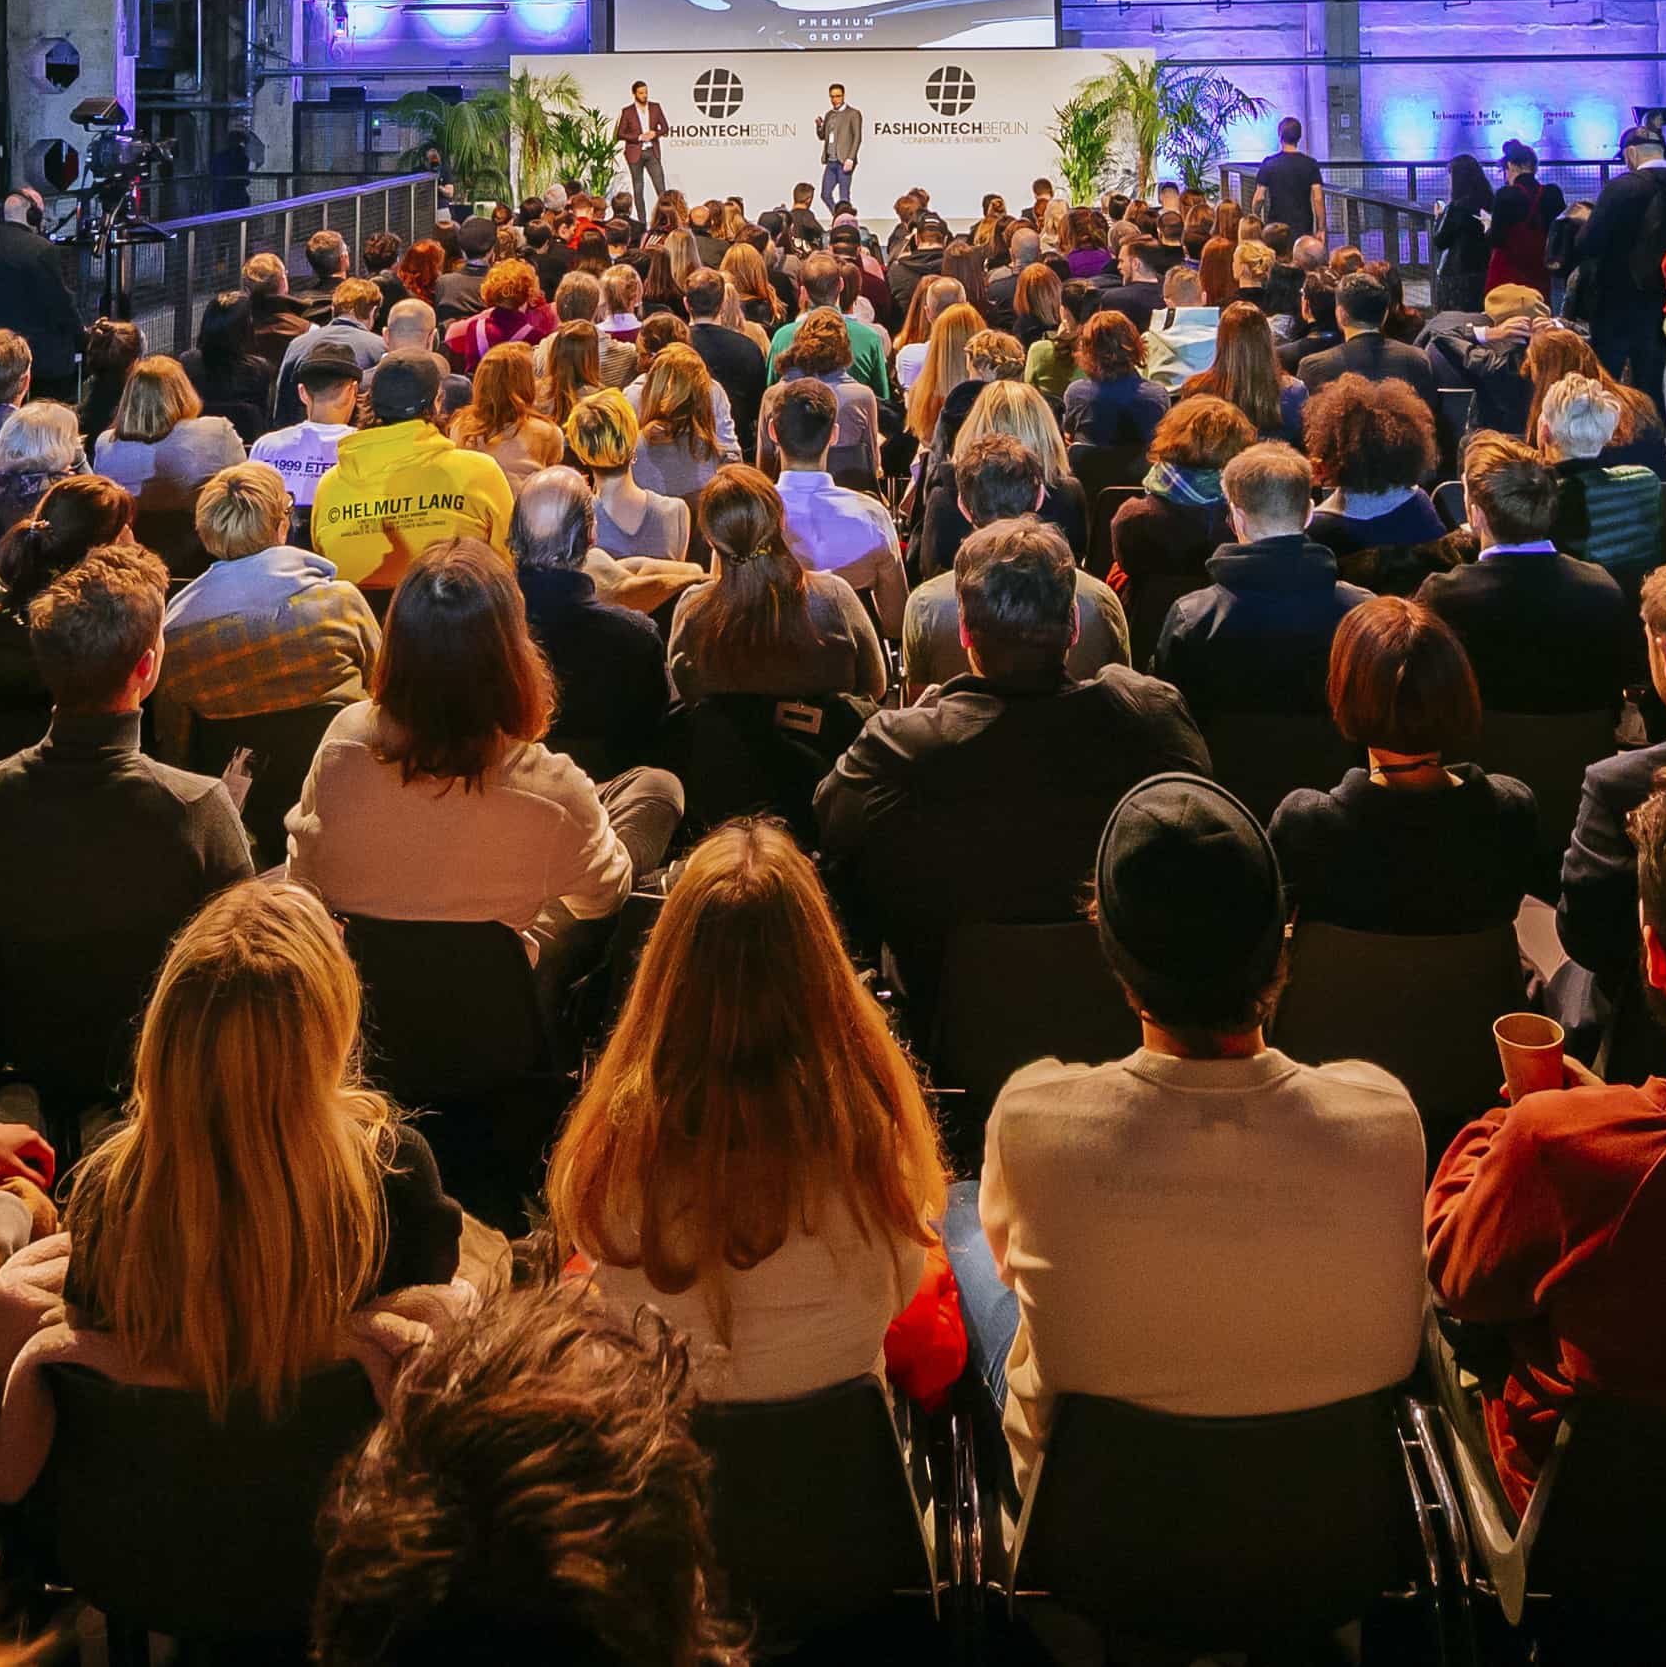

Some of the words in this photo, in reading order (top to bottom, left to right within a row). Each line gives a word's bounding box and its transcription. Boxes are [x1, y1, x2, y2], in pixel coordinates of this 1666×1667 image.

[798, 18, 874, 27] PREMIUM
[809, 33, 864, 42] GROUP
[669, 122, 797, 138] HIONTECHBERLIN
[274, 460, 302, 471] 1999
[419, 494, 465, 510] LANG
